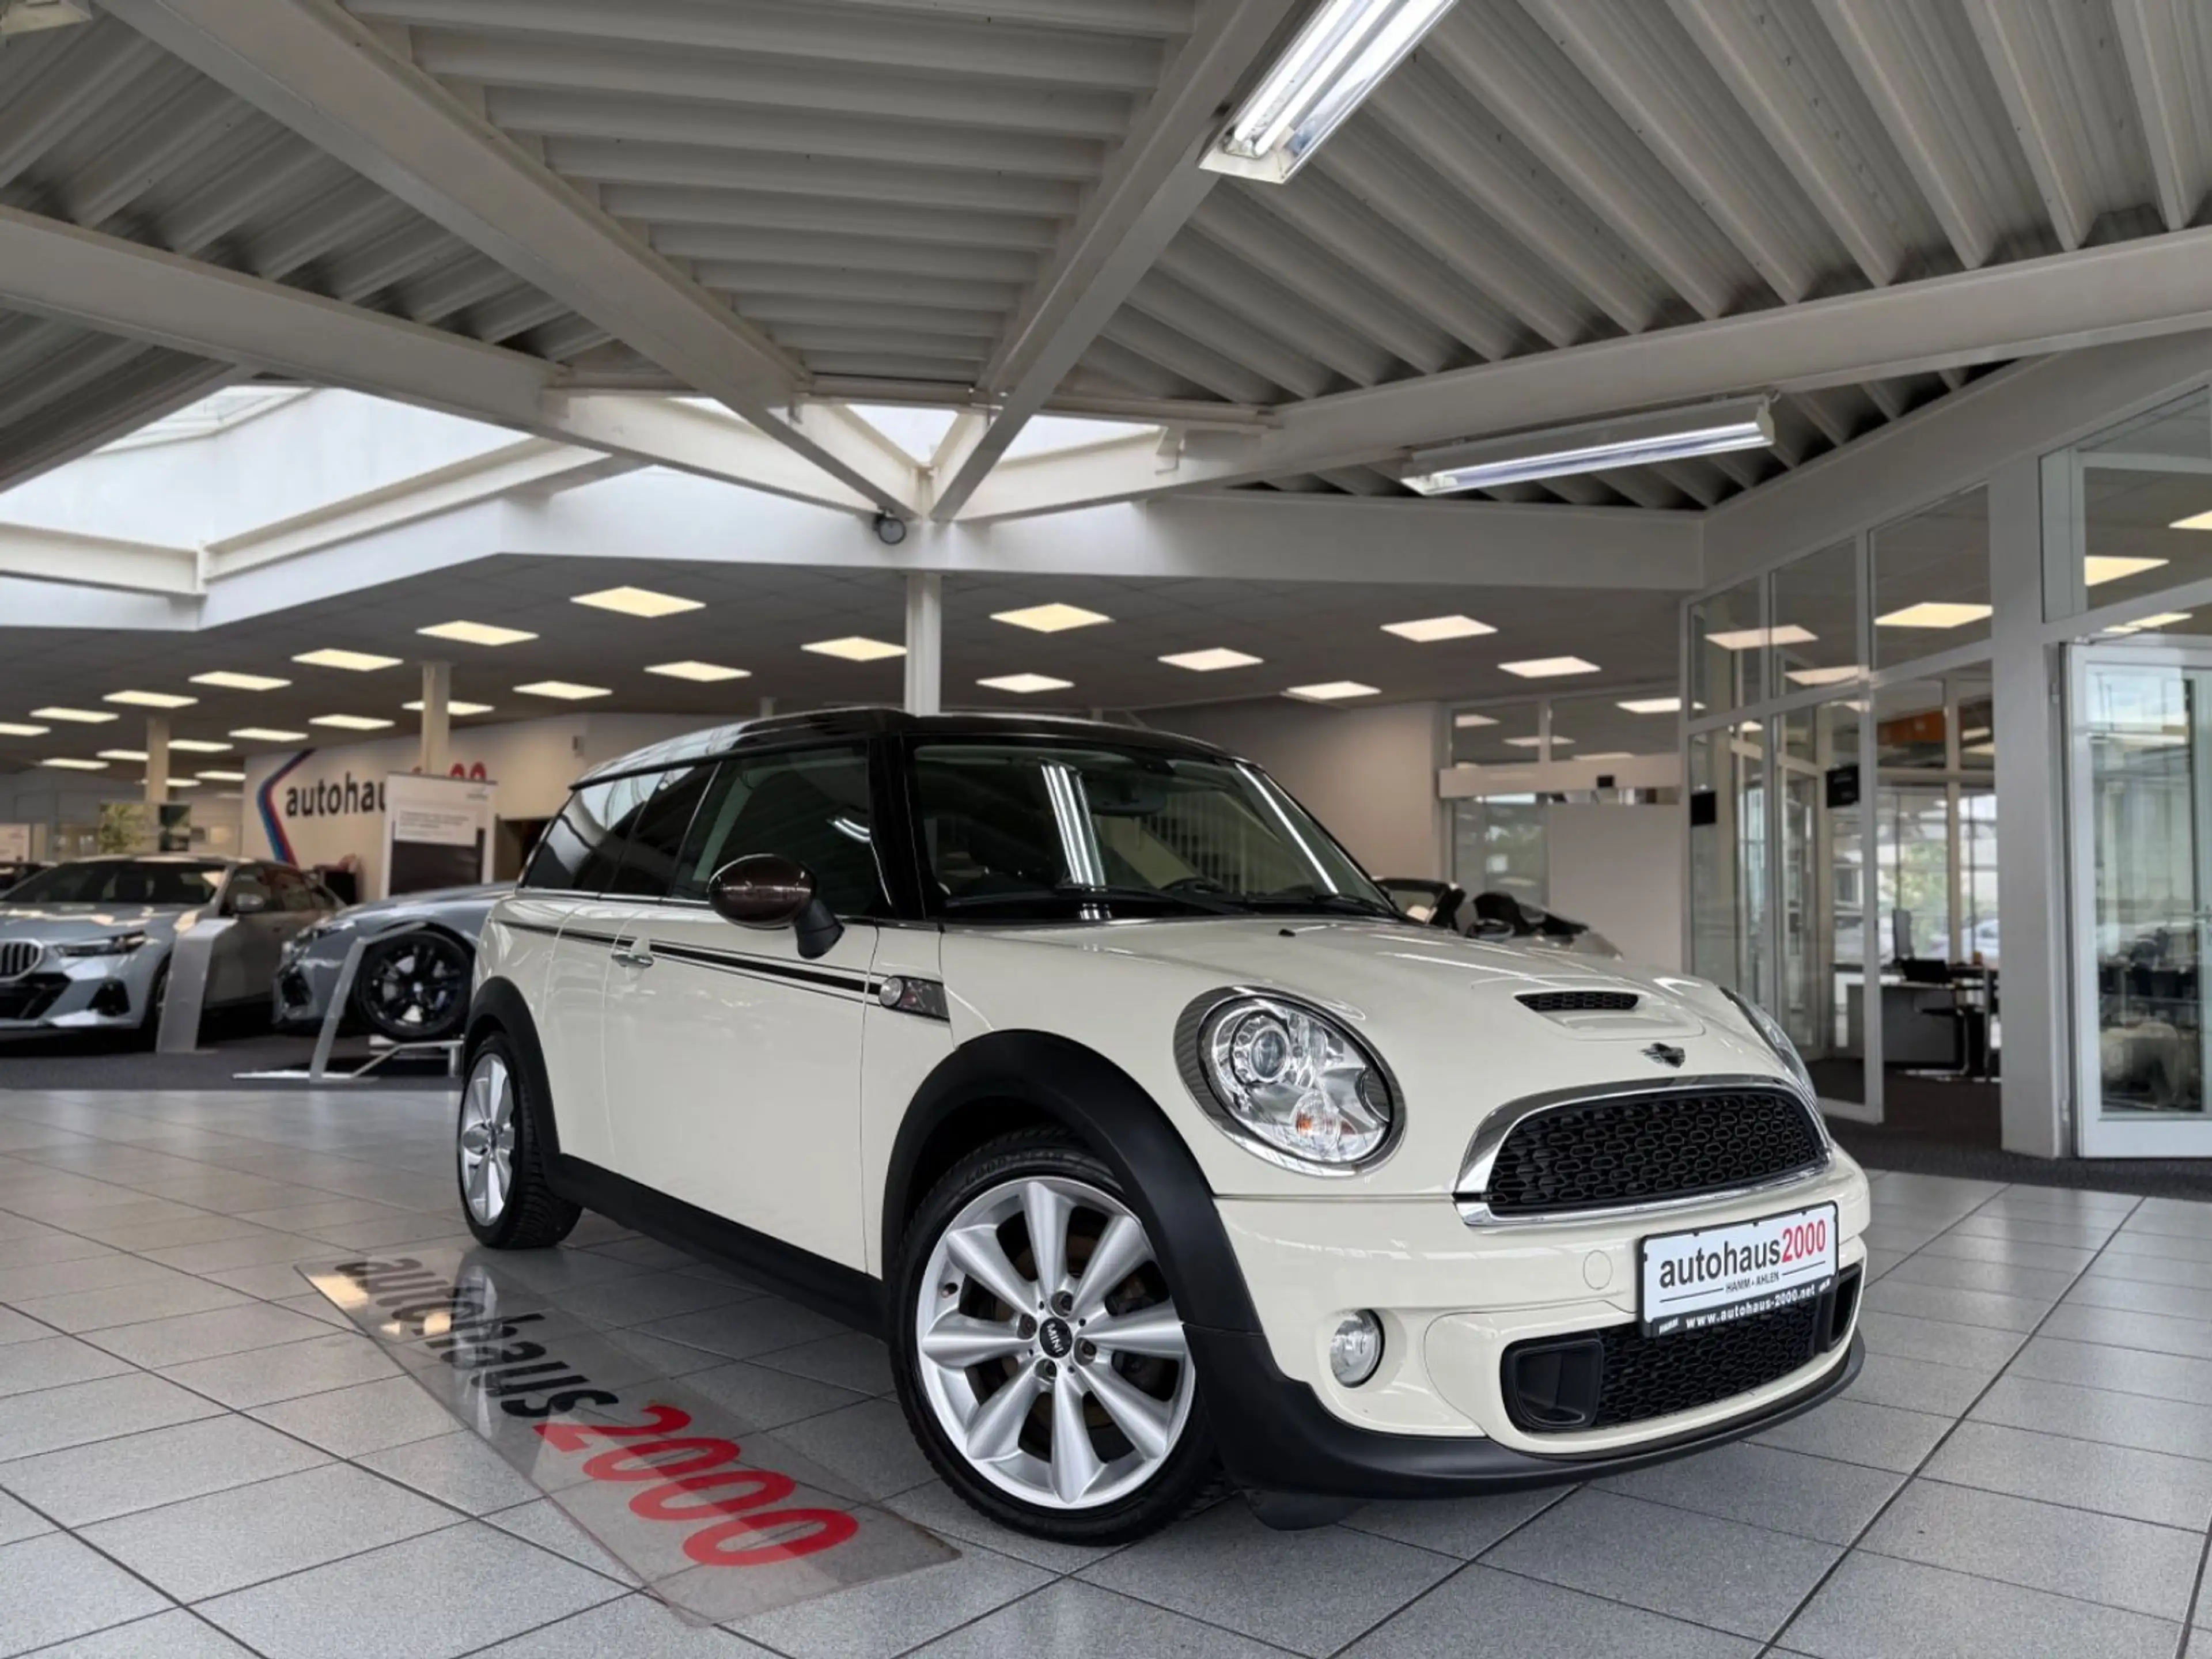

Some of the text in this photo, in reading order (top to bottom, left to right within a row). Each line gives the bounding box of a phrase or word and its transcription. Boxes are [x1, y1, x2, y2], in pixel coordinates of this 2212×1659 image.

[1660, 1219, 1825, 1288] autohaus2000
[1685, 1283, 1815, 1330] www.autohaus-2000.net
[334, 1257, 858, 1567] autohaus2000
